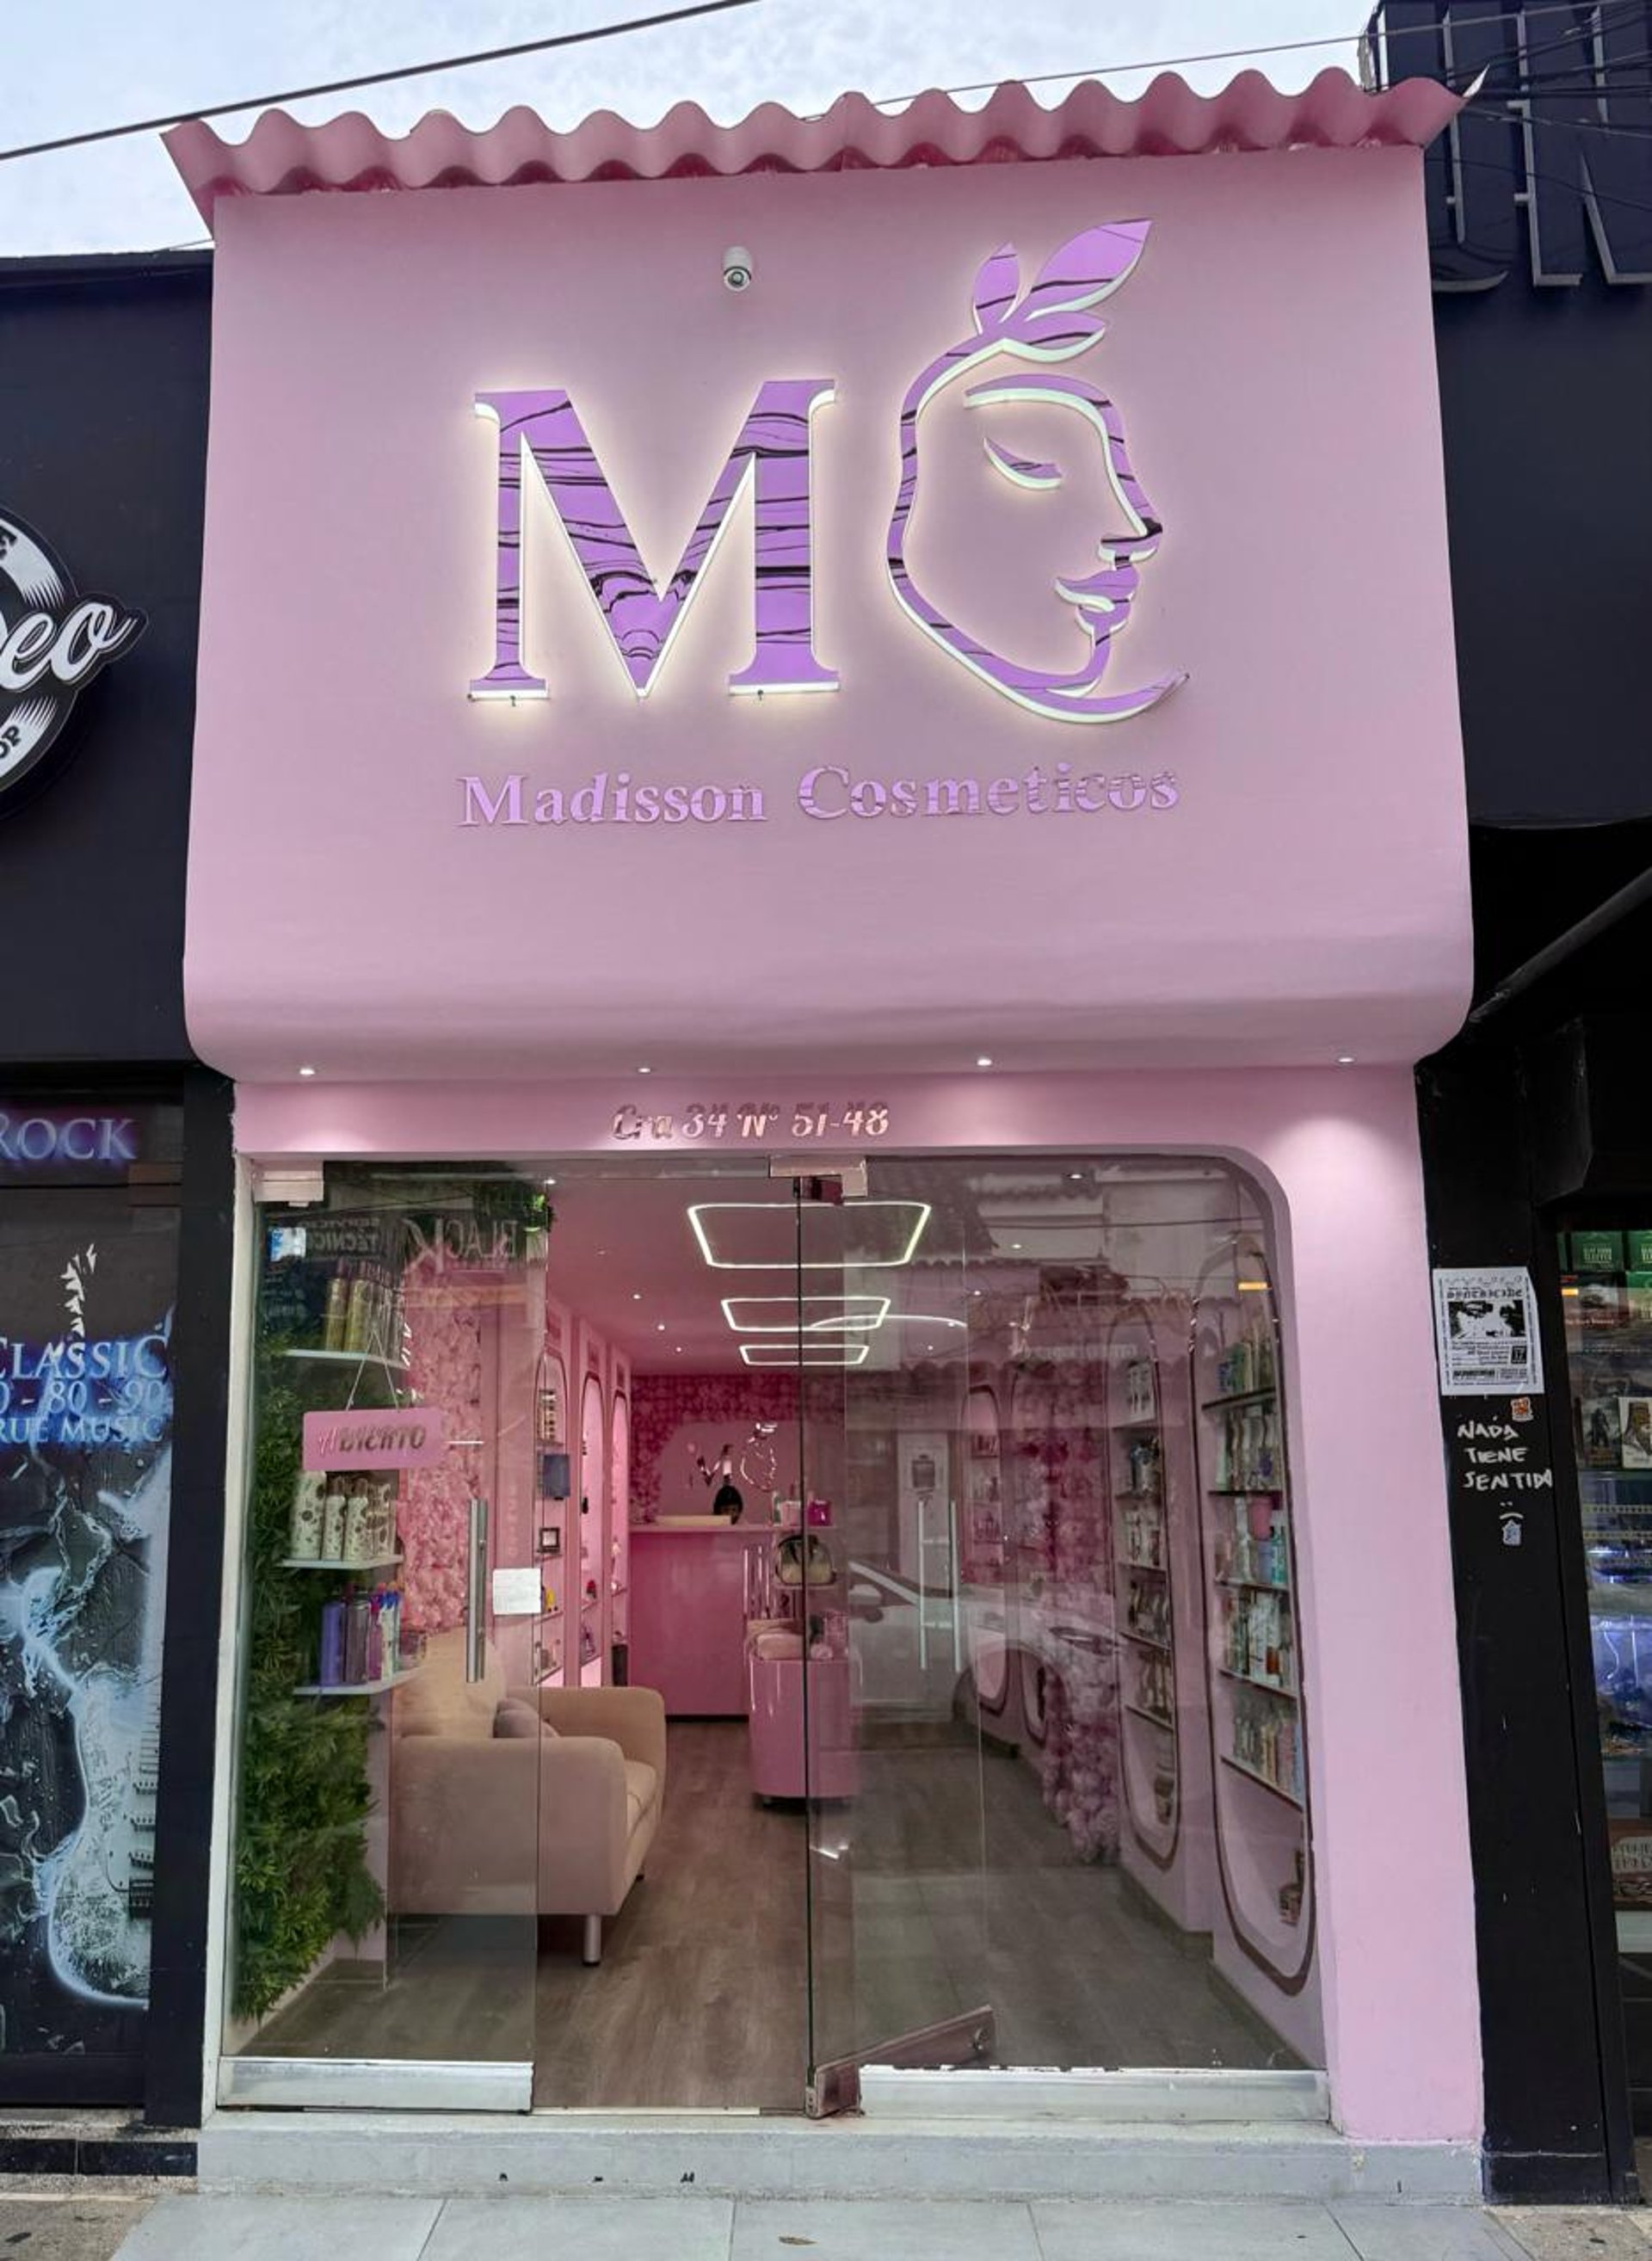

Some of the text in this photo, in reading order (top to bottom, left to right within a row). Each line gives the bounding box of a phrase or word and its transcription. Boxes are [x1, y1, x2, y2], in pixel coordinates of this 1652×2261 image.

[0, 602, 138, 690] eo
[455, 762, 1180, 827] Madisson Cosmeticos
[682, 1103, 728, 1138] 34
[791, 1100, 890, 1137] 51-48
[48, 1380, 88, 1416] 80
[118, 1380, 164, 1416] 90
[61, 1415, 164, 1444] MUSIC
[1457, 1419, 1519, 1441] NADA
[1464, 1447, 1528, 1463] TIENE
